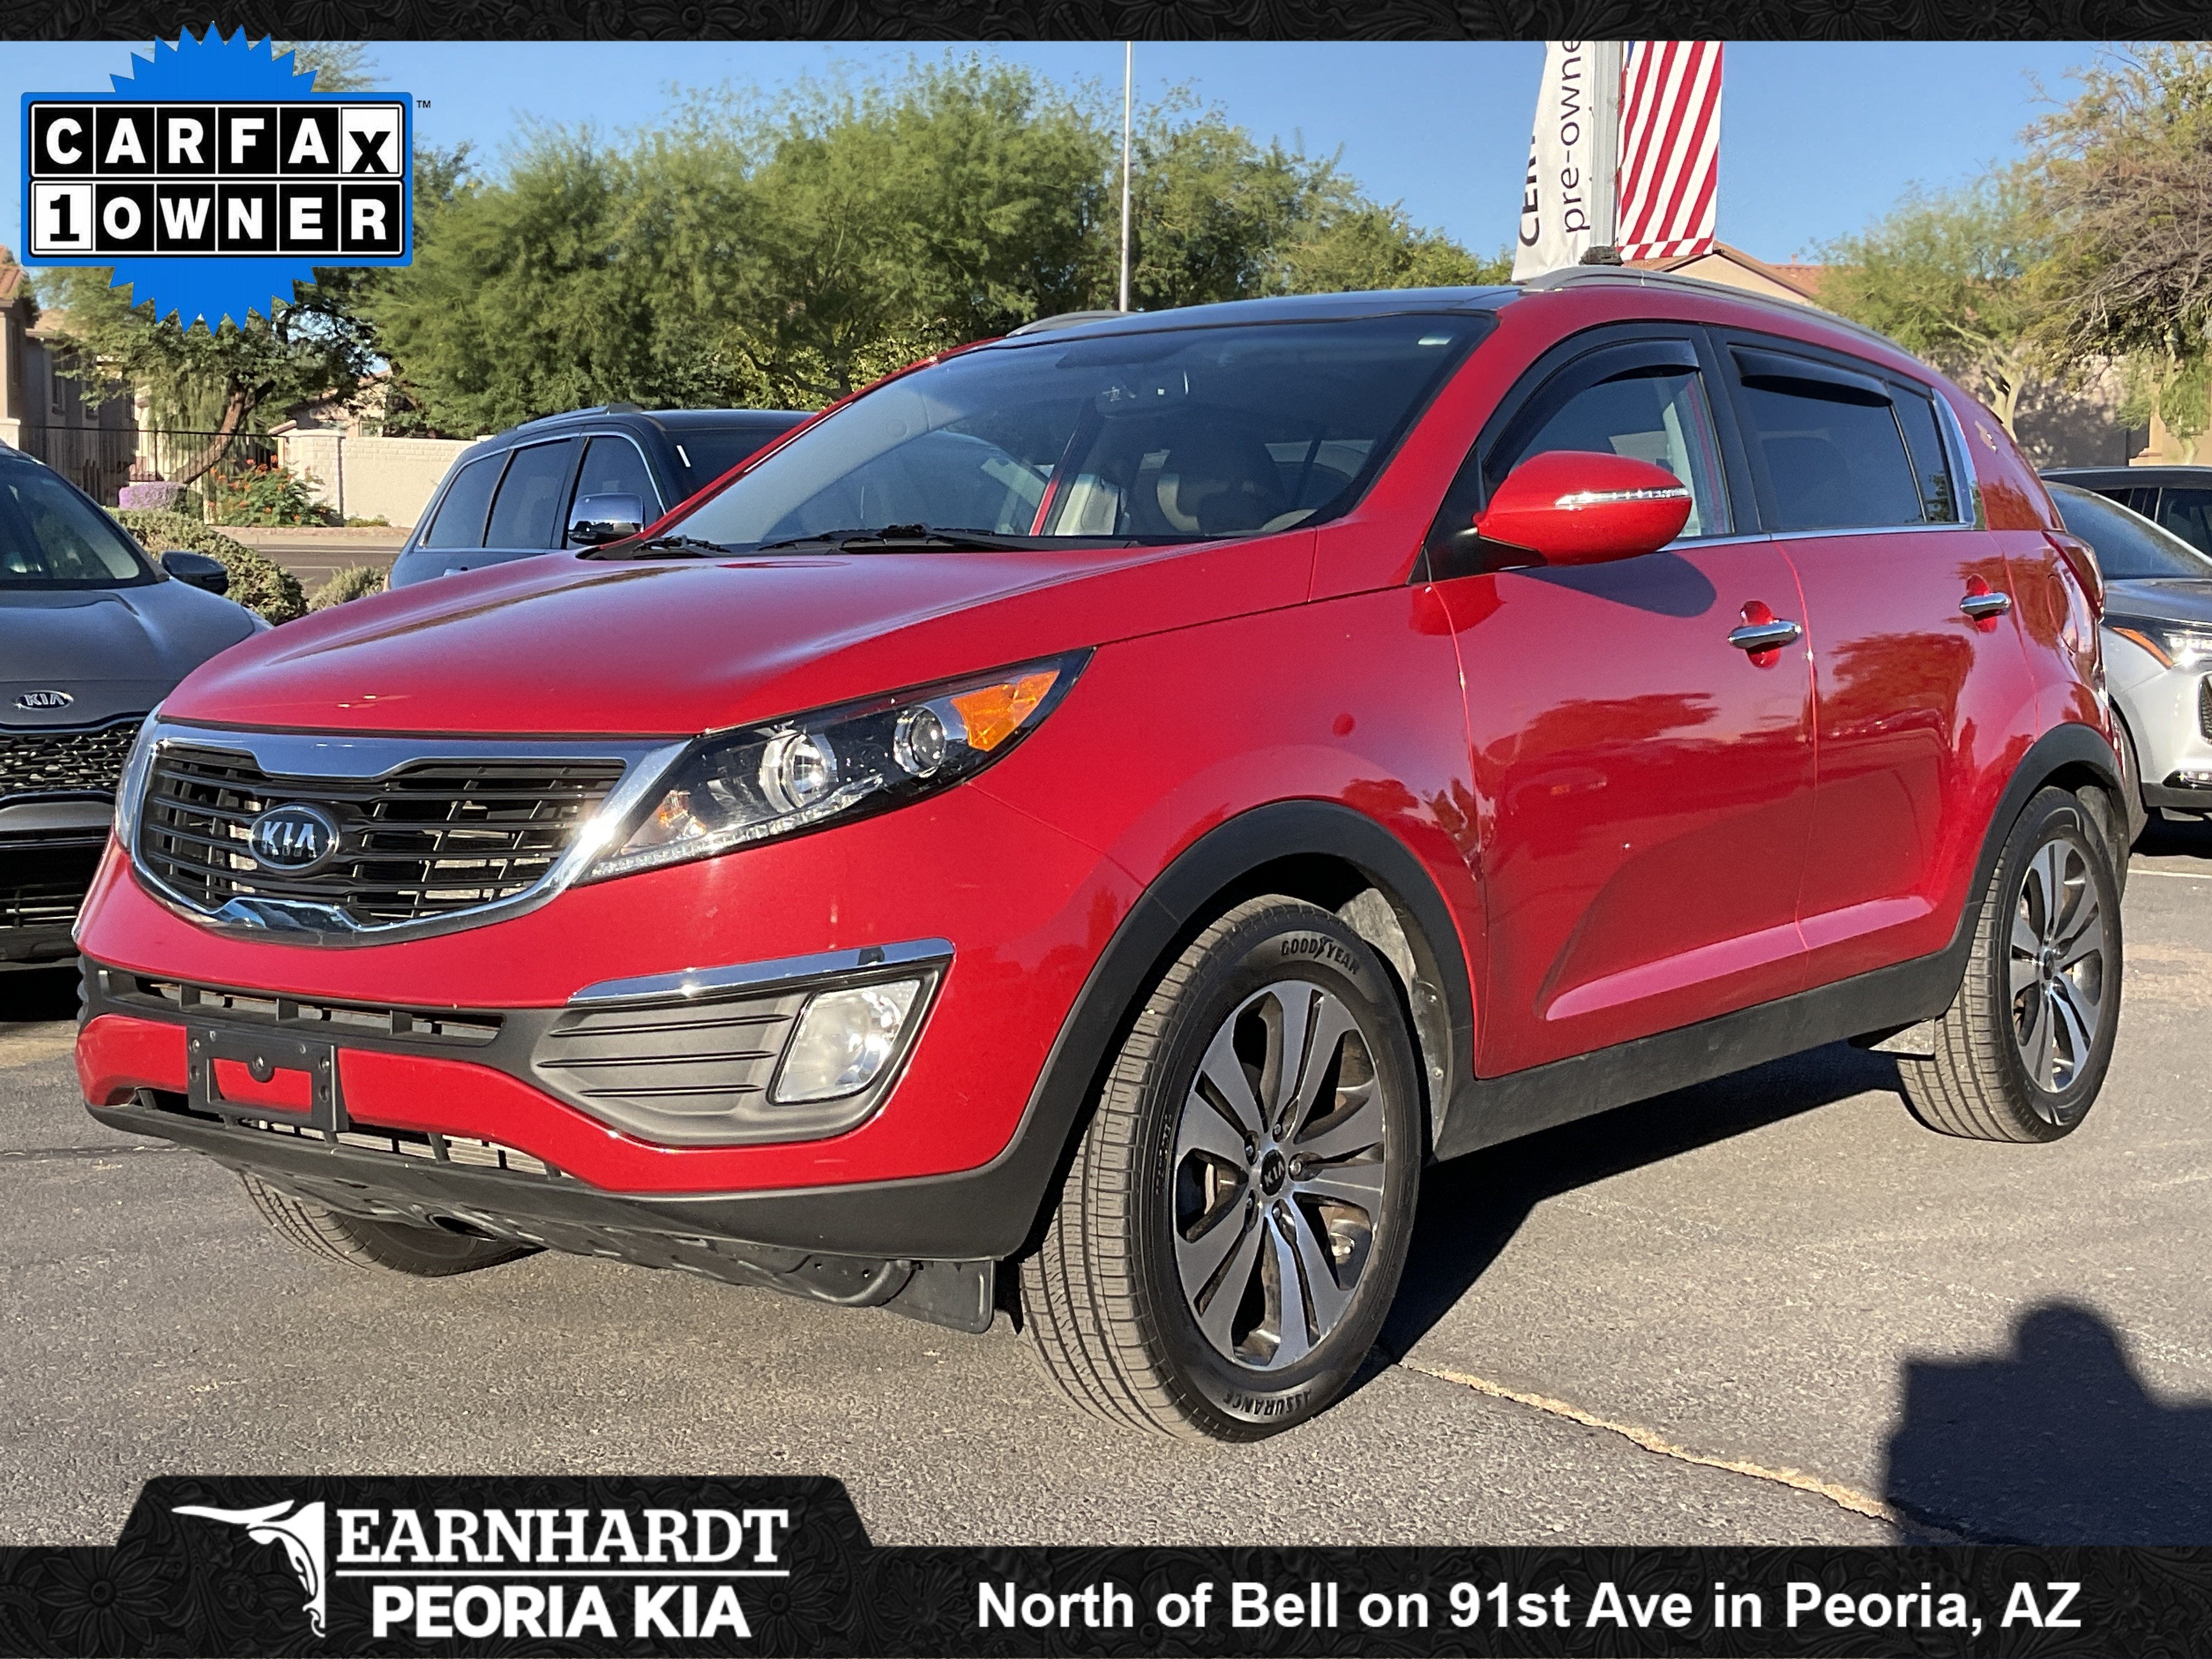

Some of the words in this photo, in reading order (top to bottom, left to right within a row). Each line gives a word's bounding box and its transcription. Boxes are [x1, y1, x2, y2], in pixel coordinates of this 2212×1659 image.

[23, 693, 65, 706] KIA
[261, 821, 317, 858] KIA
[1263, 1160, 1285, 1188] KIA
[1223, 1389, 1312, 1416] ASSURANCE
